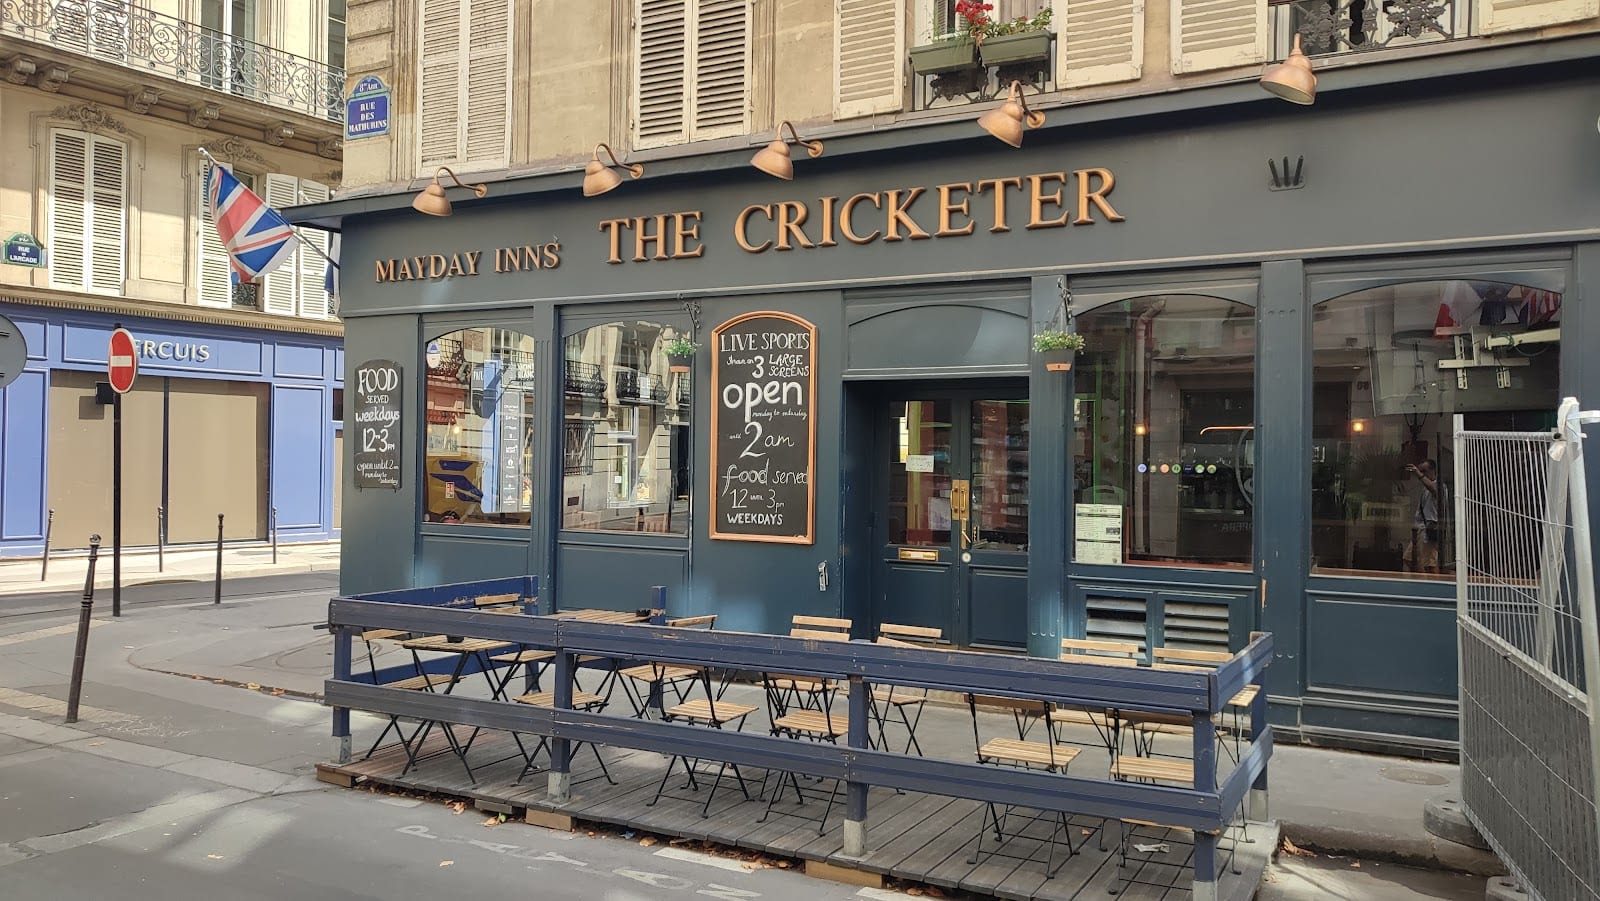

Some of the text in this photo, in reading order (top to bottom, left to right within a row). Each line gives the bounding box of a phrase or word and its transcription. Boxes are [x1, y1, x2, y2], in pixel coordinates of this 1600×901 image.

[360, 101, 376, 112] RUE
[360, 111, 375, 121] DES
[348, 119, 387, 133] MATHURINS
[599, 167, 1126, 265] THE CRICKETER
[375, 242, 562, 283] MAYDAY INNS
[721, 332, 810, 352] LIVE SPORTS
[752, 355, 765, 379] 3
[768, 353, 803, 367] LARGE
[358, 367, 399, 396] FOOD
[768, 366, 810, 378] SCREENS
[365, 394, 389, 404] SERVED
[723, 381, 803, 423] open
[355, 405, 400, 428] weekdays
[363, 428, 377, 452] 12
[722, 458, 808, 497] food served
[730, 488, 748, 509] 12
[727, 513, 784, 526] WEEKDAYS
